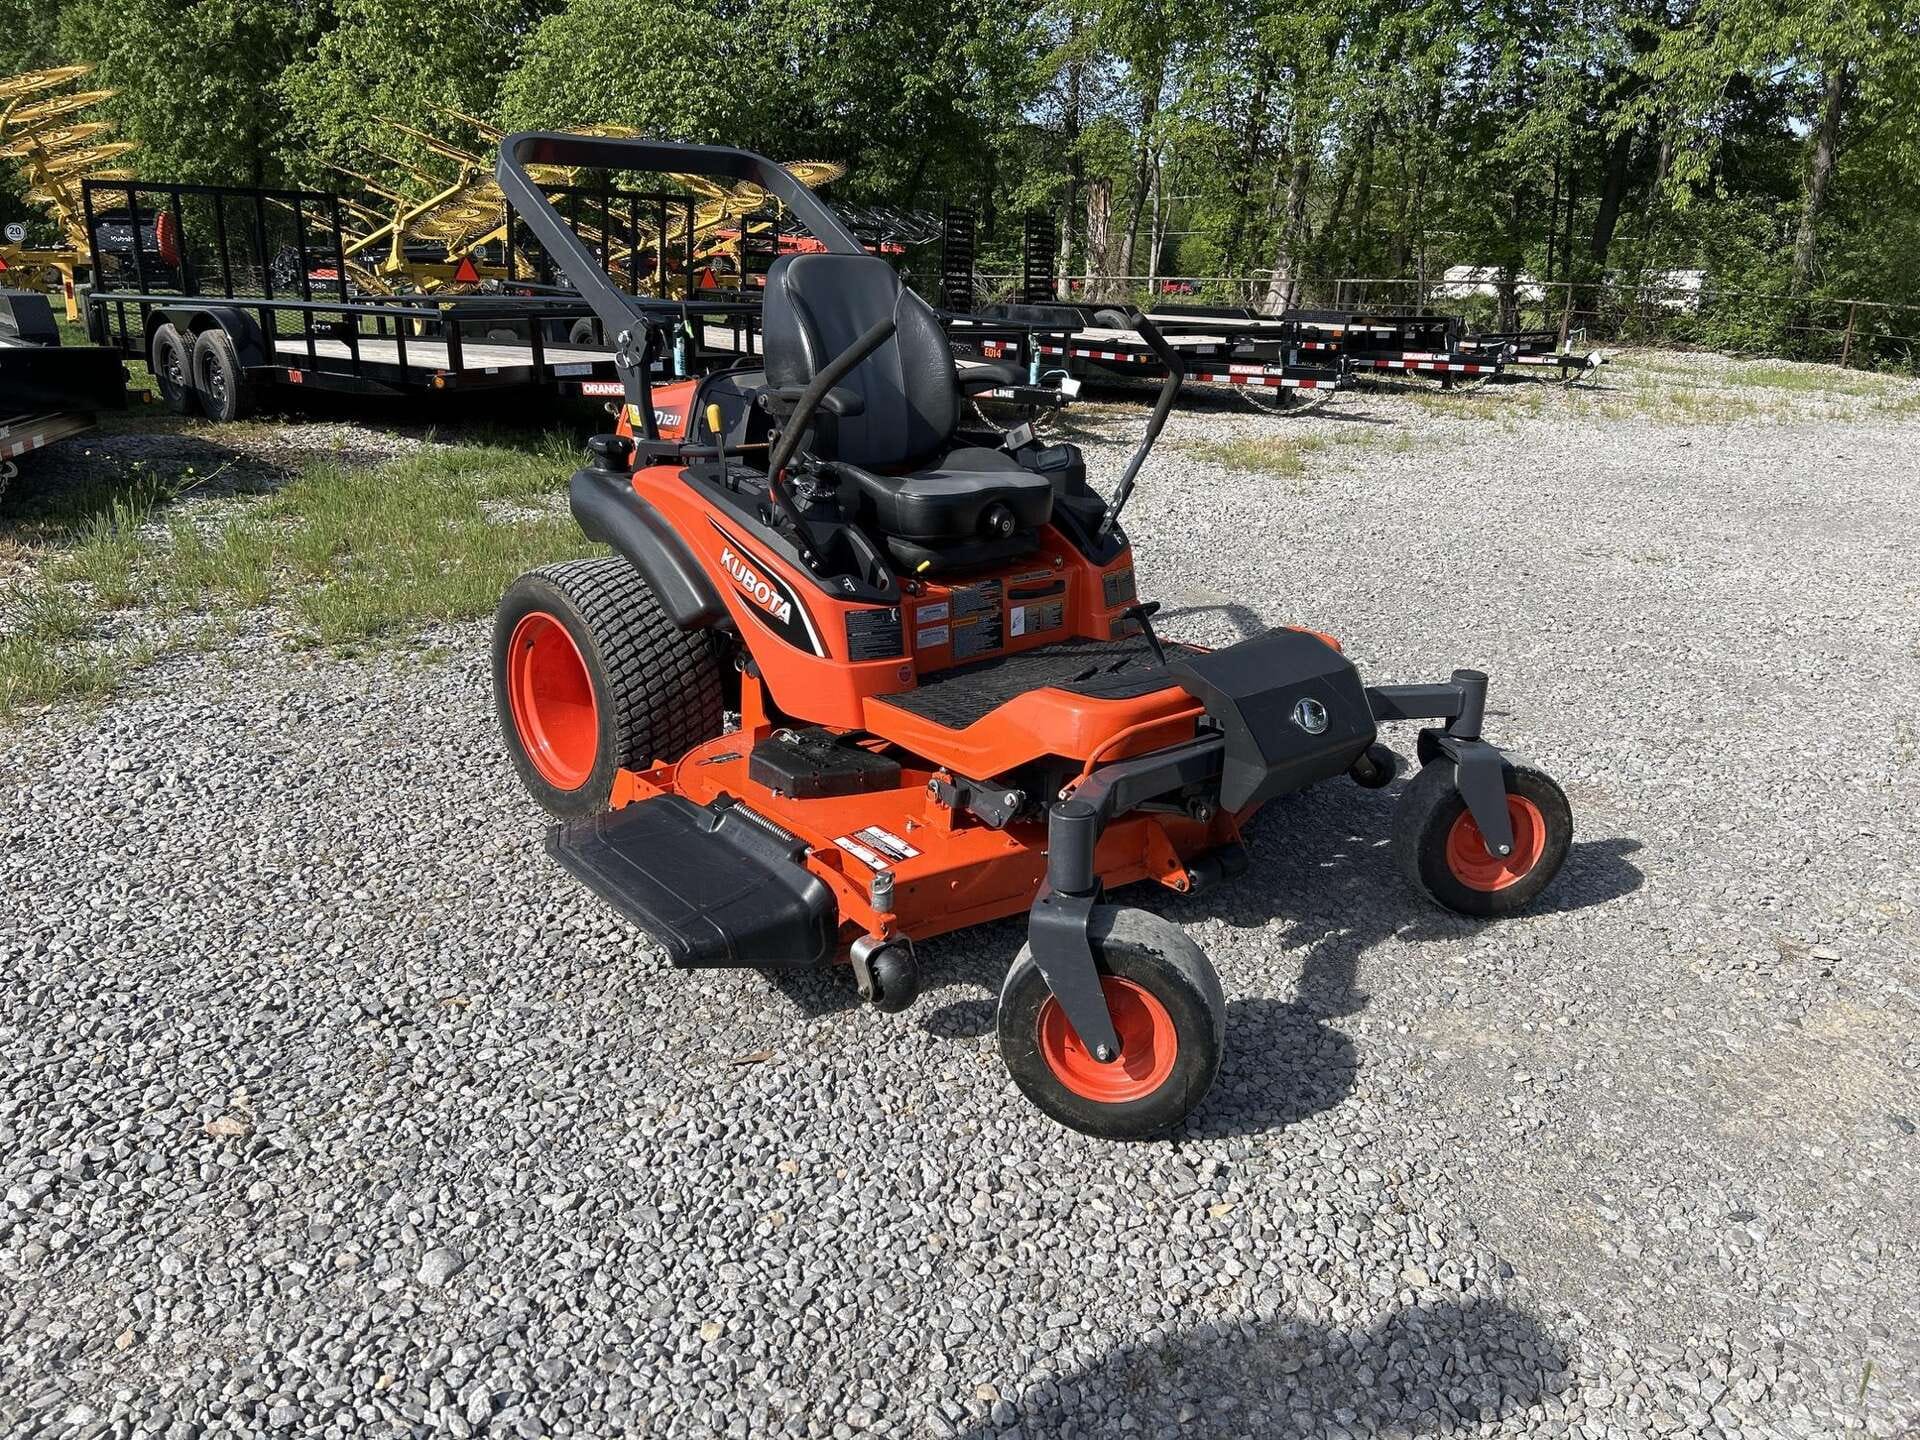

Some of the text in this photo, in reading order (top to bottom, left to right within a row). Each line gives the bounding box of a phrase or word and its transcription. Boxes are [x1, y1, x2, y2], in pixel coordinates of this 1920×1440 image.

[9, 226, 21, 235] 20
[1230, 365, 1283, 376] ORANGE LINE
[584, 384, 625, 394] ORANGE
[993, 388, 1015, 399] LINE
[720, 547, 792, 625] KUBOTA
